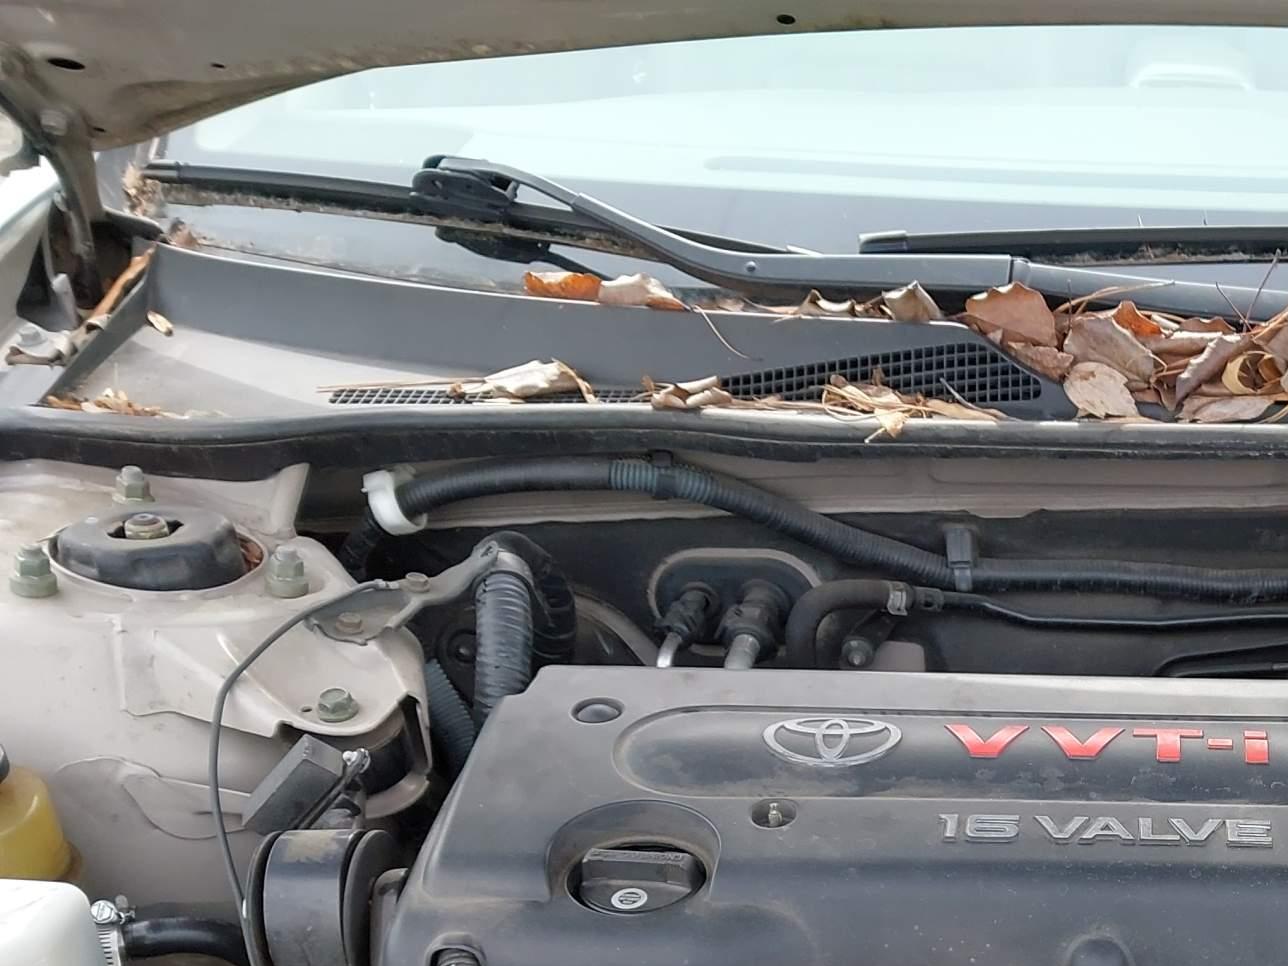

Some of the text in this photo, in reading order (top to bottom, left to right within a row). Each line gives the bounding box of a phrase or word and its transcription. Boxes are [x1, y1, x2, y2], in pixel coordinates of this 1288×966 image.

[944, 724, 1269, 764] VVT-i
[939, 814, 1273, 847] 16 VALVE
